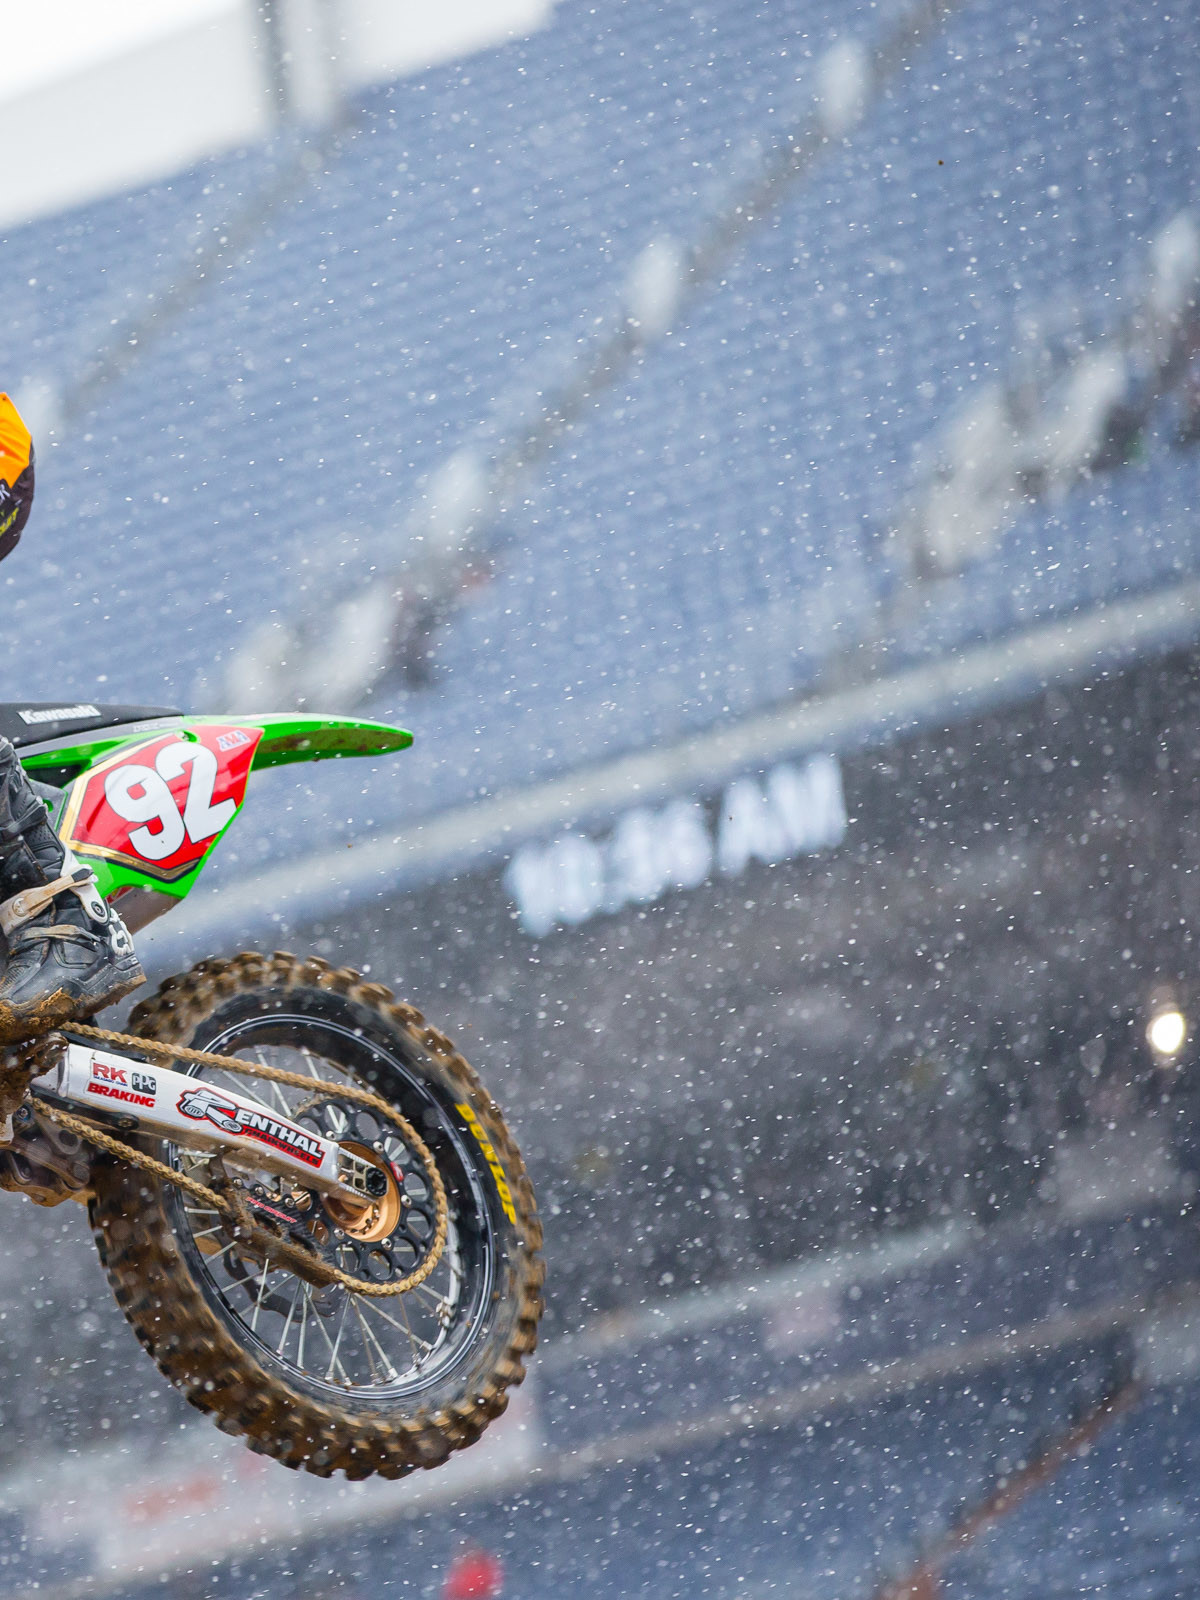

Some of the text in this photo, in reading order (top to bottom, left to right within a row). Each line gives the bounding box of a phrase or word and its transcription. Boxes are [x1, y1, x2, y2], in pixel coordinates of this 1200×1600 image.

[17, 703, 102, 725] Kawasaki
[104, 741, 238, 862] 92
[93, 1062, 128, 1084] RK
[132, 1073, 156, 1092] PPG
[87, 1082, 156, 1108] BRAKING
[244, 1127, 320, 1167] CHAINWHEELS
[454, 1103, 518, 1225] DUNLOP
